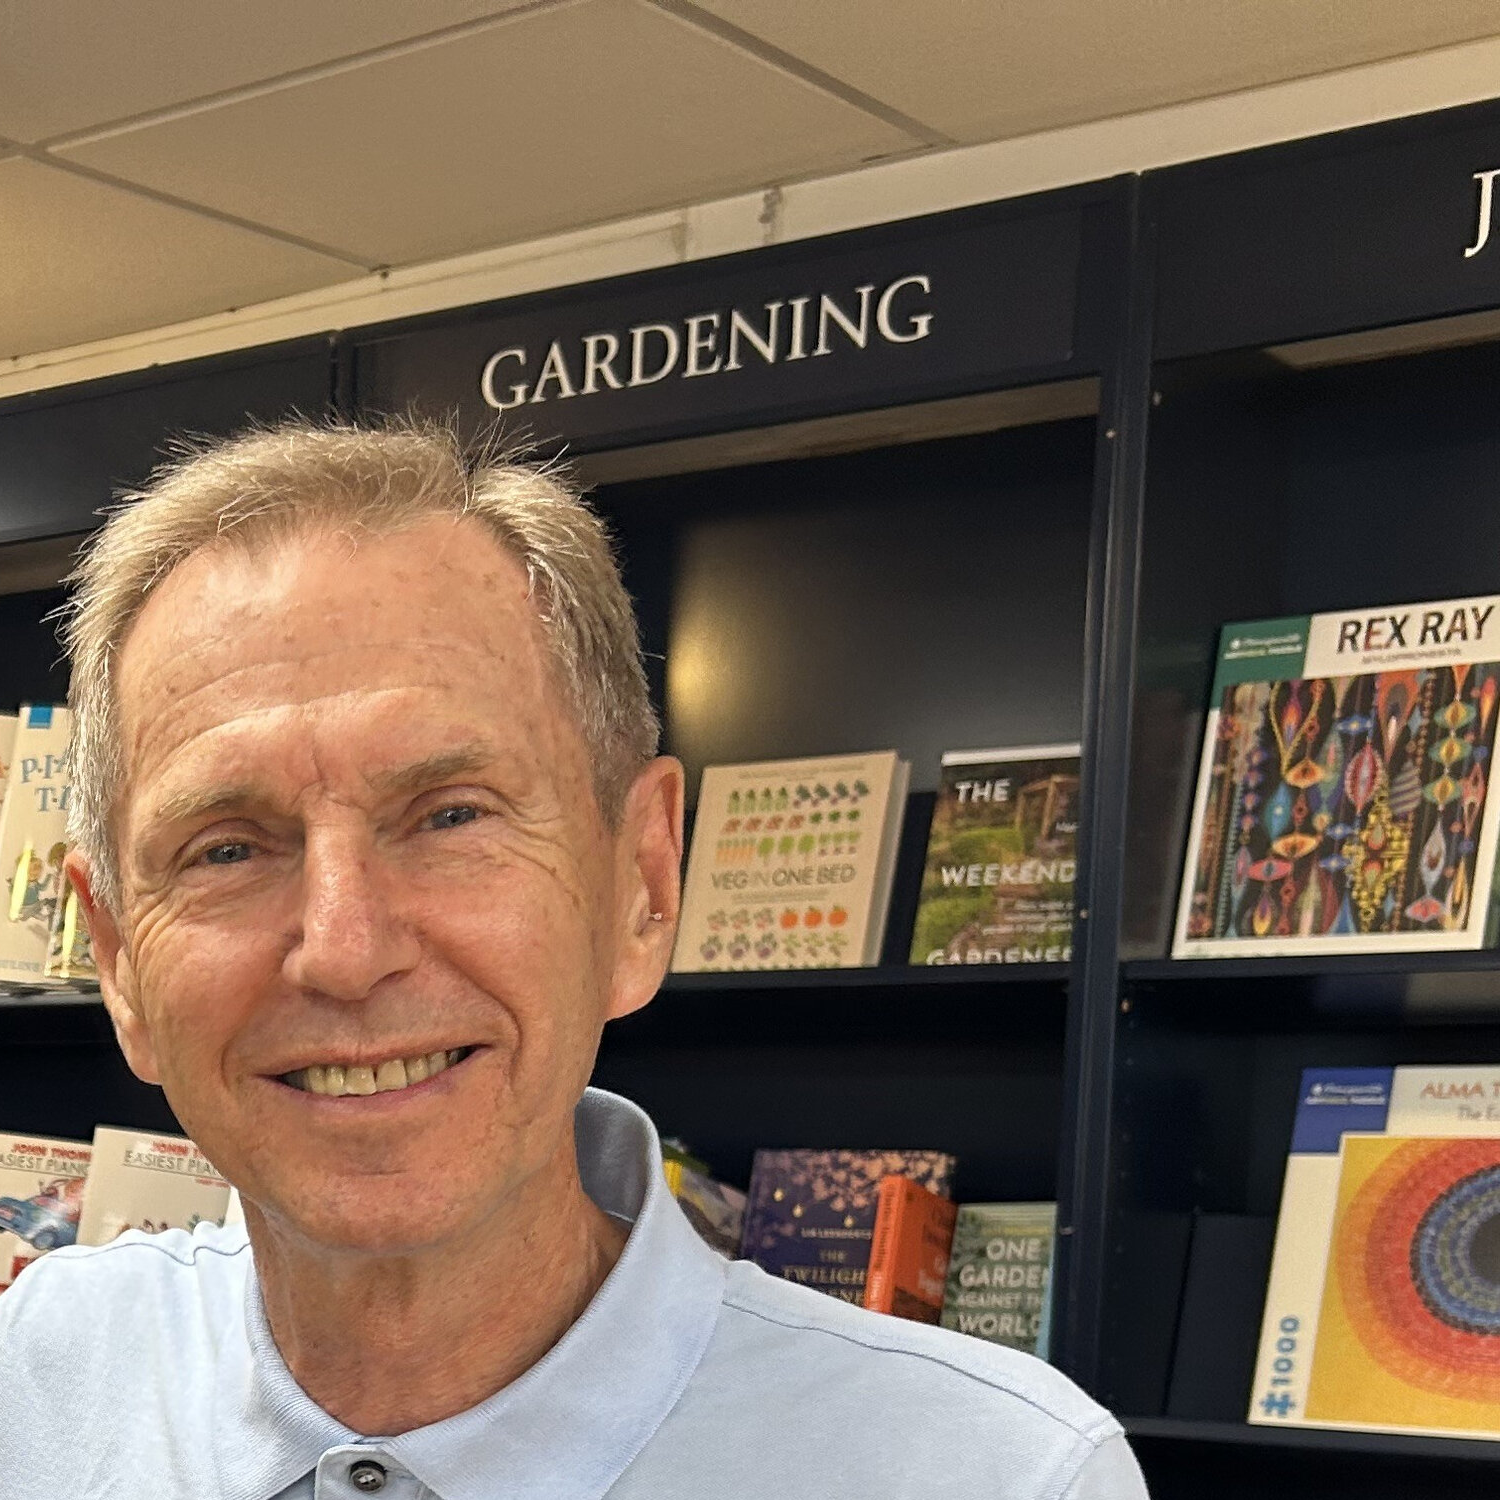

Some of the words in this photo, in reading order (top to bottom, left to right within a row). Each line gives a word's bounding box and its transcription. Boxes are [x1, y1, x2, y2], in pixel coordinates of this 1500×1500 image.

[480, 274, 935, 410] GARDENING
[1336, 612, 1410, 655] REX
[1418, 604, 1496, 647] RAY
[955, 777, 1012, 804] THE
[710, 868, 749, 891] VEG
[772, 865, 815, 887] ONE
[816, 862, 857, 885] BED
[940, 858, 1077, 888] WEEKEND
[1419, 1081, 1485, 1100] ALMA
[124, 1149, 184, 1171] EASIEST
[986, 1237, 1042, 1262] ONE
[1271, 1314, 1300, 1386] 1000
